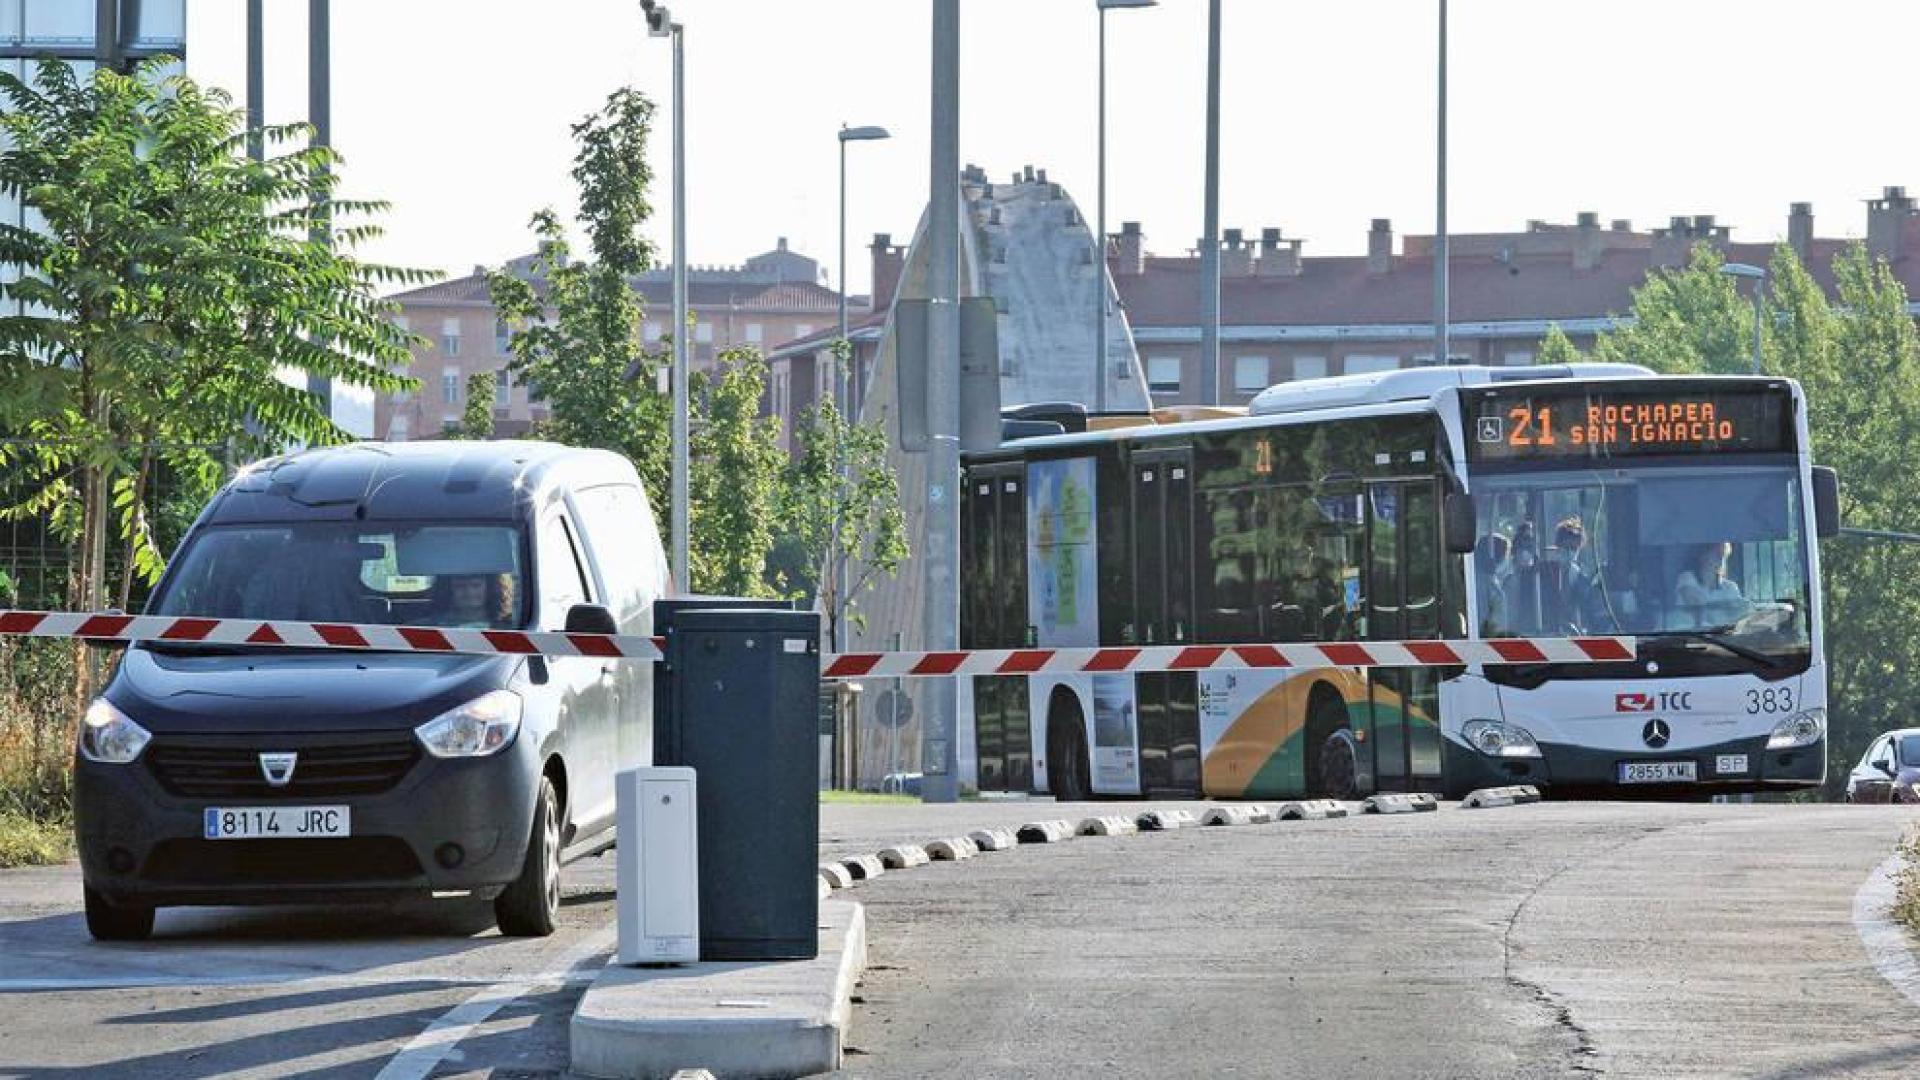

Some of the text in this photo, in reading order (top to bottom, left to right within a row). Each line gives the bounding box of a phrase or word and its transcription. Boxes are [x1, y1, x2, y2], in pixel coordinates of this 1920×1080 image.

[1588, 403, 1714, 424] ROCHAPEA
[1509, 408, 1553, 445] 21
[1571, 420, 1733, 444] SAN IGNACIO
[1660, 692, 1692, 710] TCC
[1746, 687, 1793, 714] 383
[1719, 757, 1744, 770] SP
[223, 810, 338, 834] 8114 JRC
